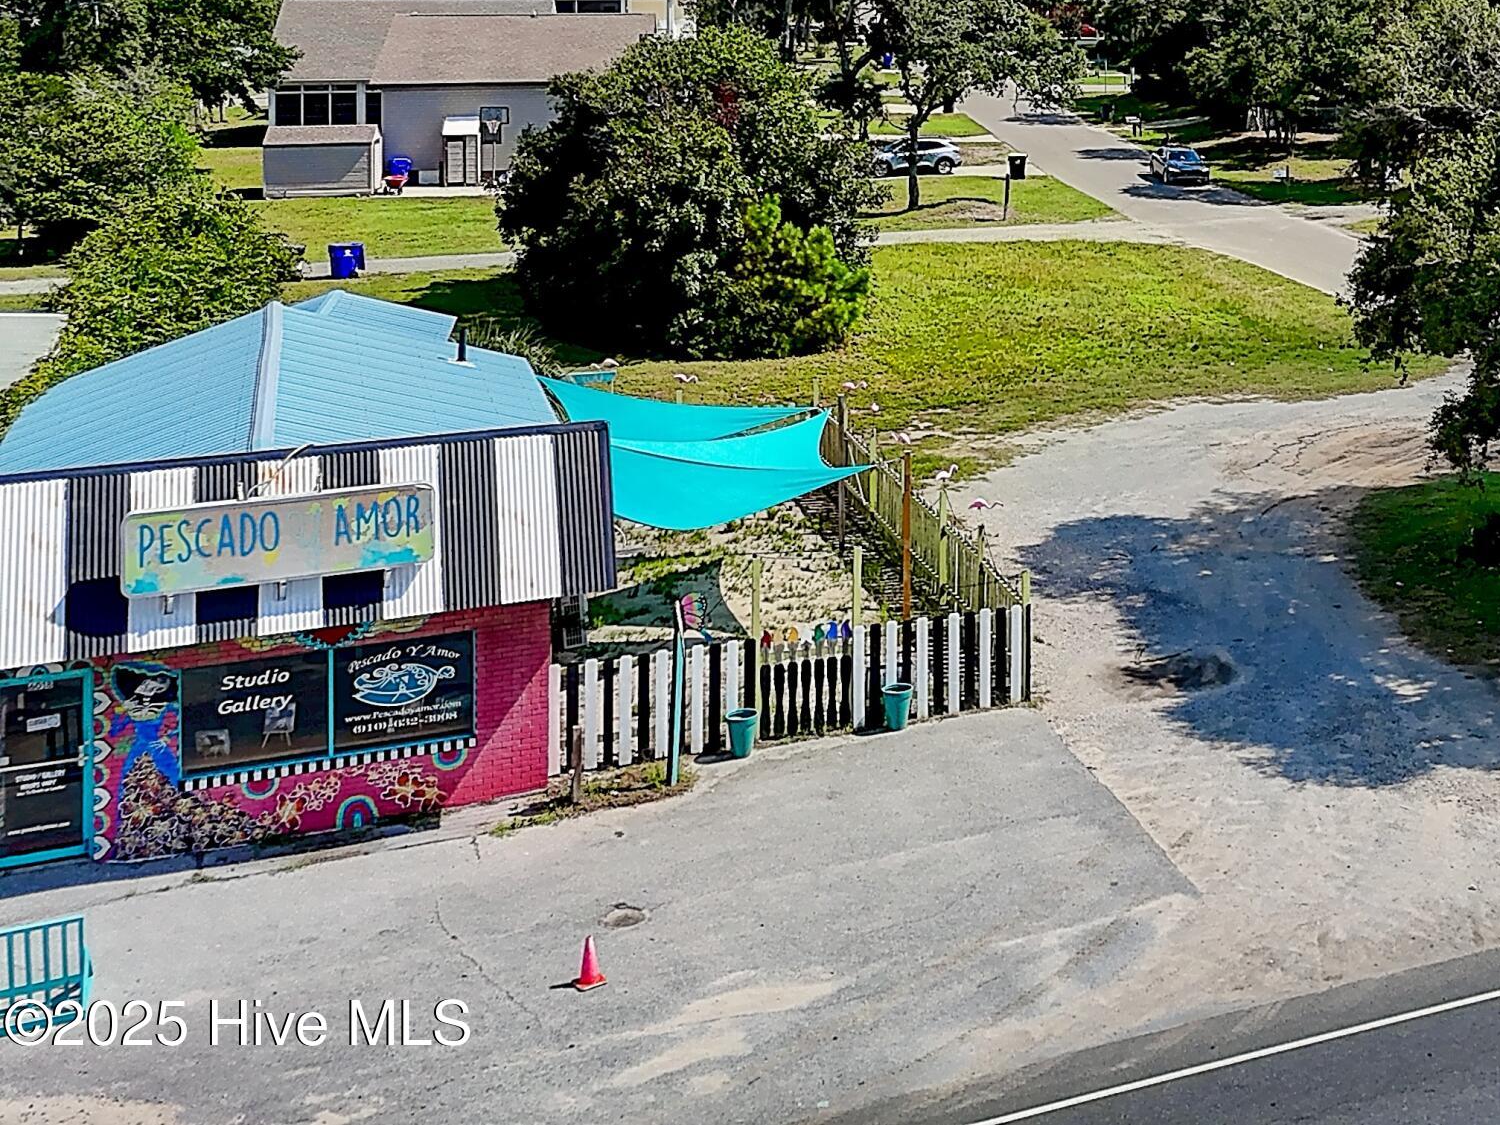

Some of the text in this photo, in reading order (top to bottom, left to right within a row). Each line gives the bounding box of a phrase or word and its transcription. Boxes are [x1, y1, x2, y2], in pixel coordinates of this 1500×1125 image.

[137, 510, 280, 568] PESCADO
[334, 493, 421, 546] AMOR
[347, 644, 460, 674] Pescado Y Amor
[220, 668, 290, 691] Studio
[217, 694, 293, 715] Gallery
[352, 720, 387, 734] (910)
